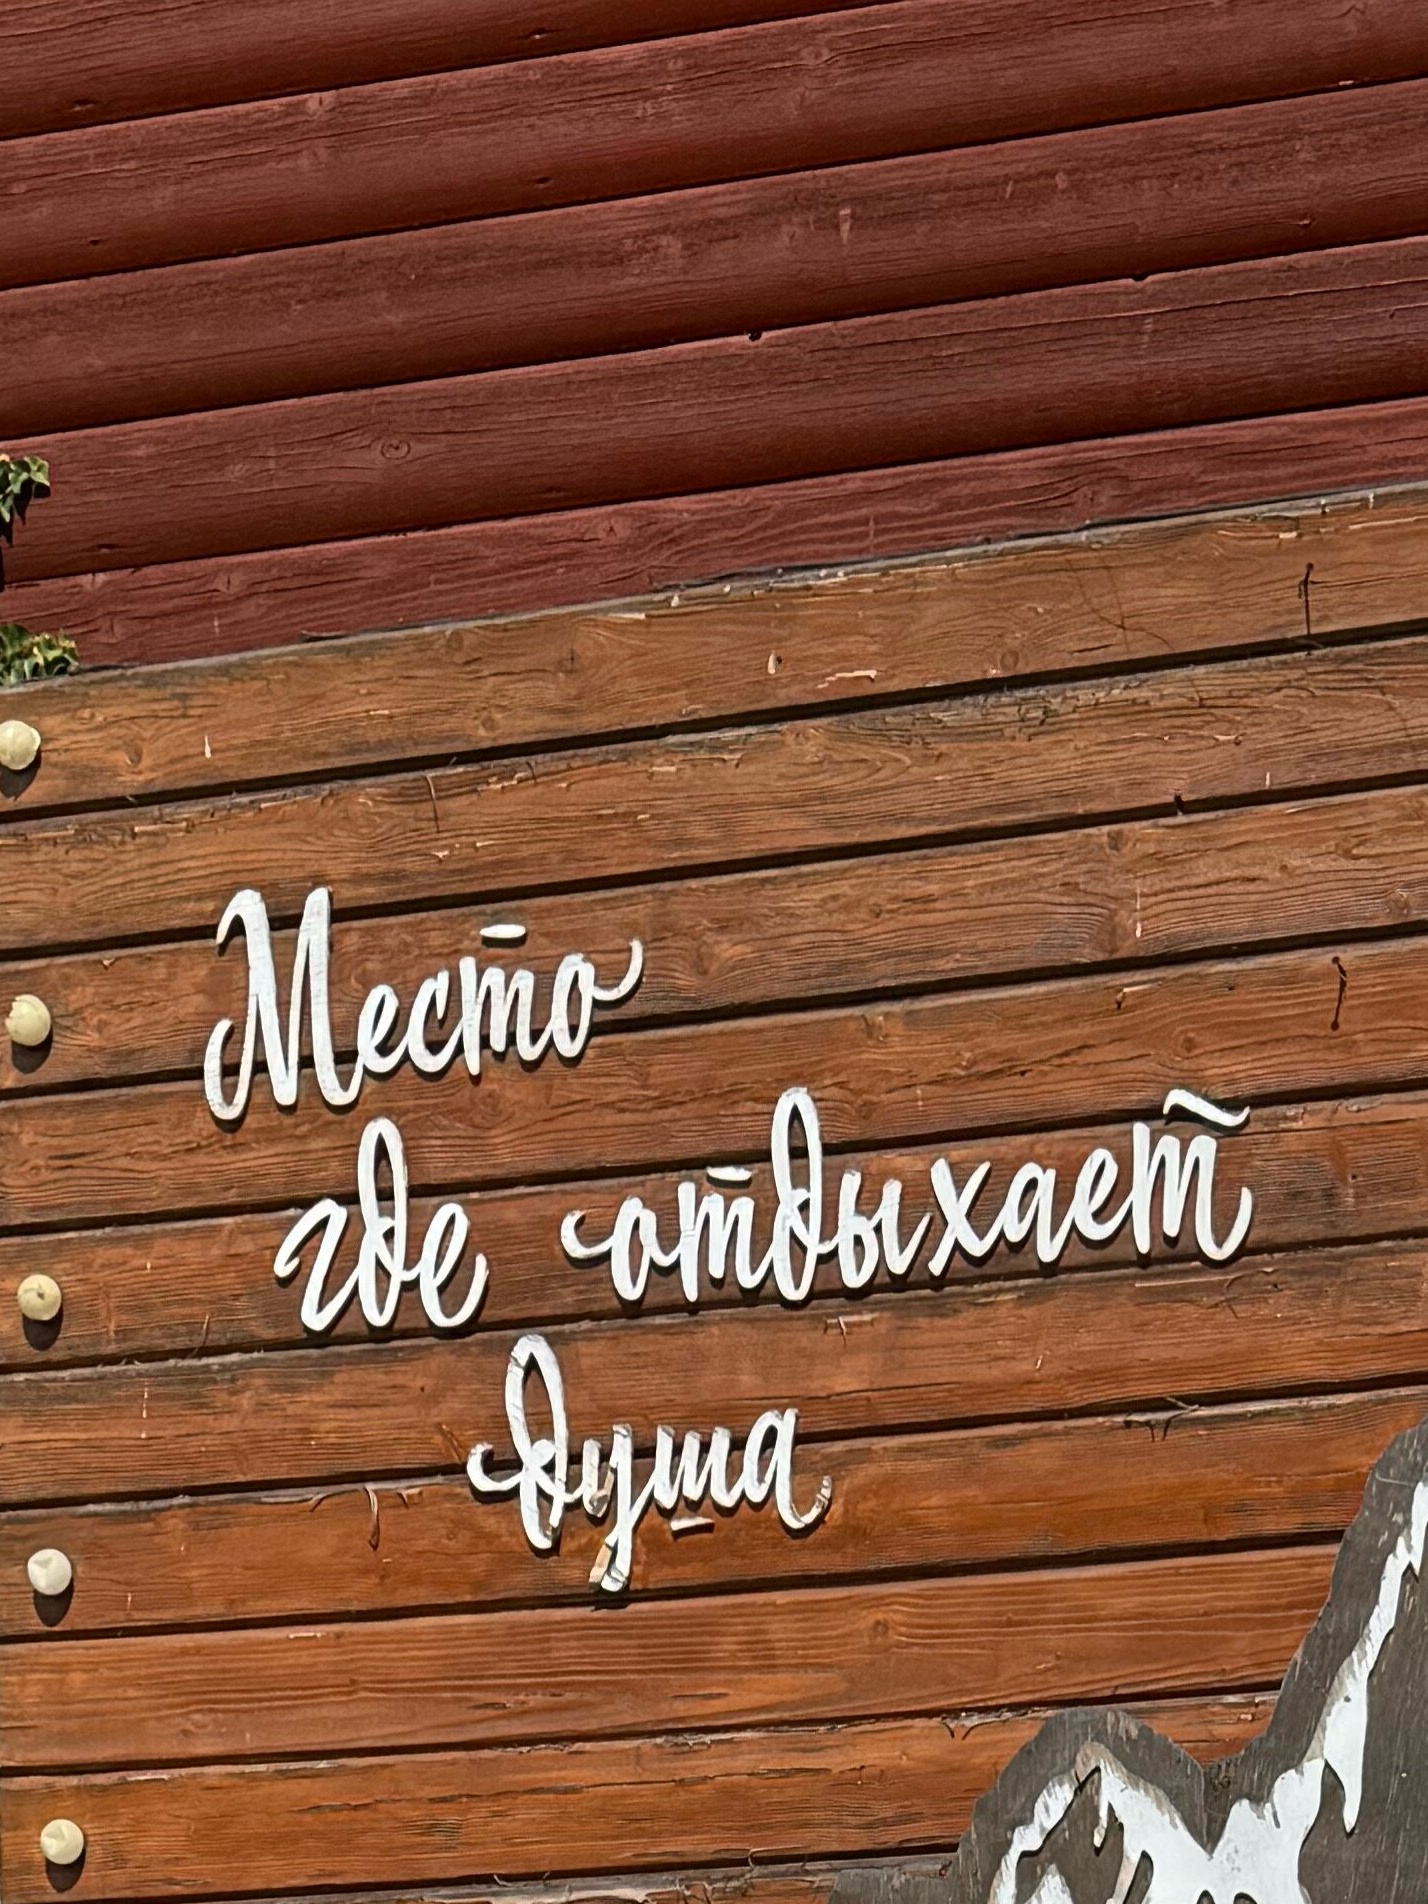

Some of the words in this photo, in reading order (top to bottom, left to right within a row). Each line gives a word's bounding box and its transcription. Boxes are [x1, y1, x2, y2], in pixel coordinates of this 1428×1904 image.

[204, 887, 644, 1122] Место
[274, 1117, 488, 1333] где
[562, 1086, 1251, 1303] отдыхает
[466, 1334, 834, 1594] душа
